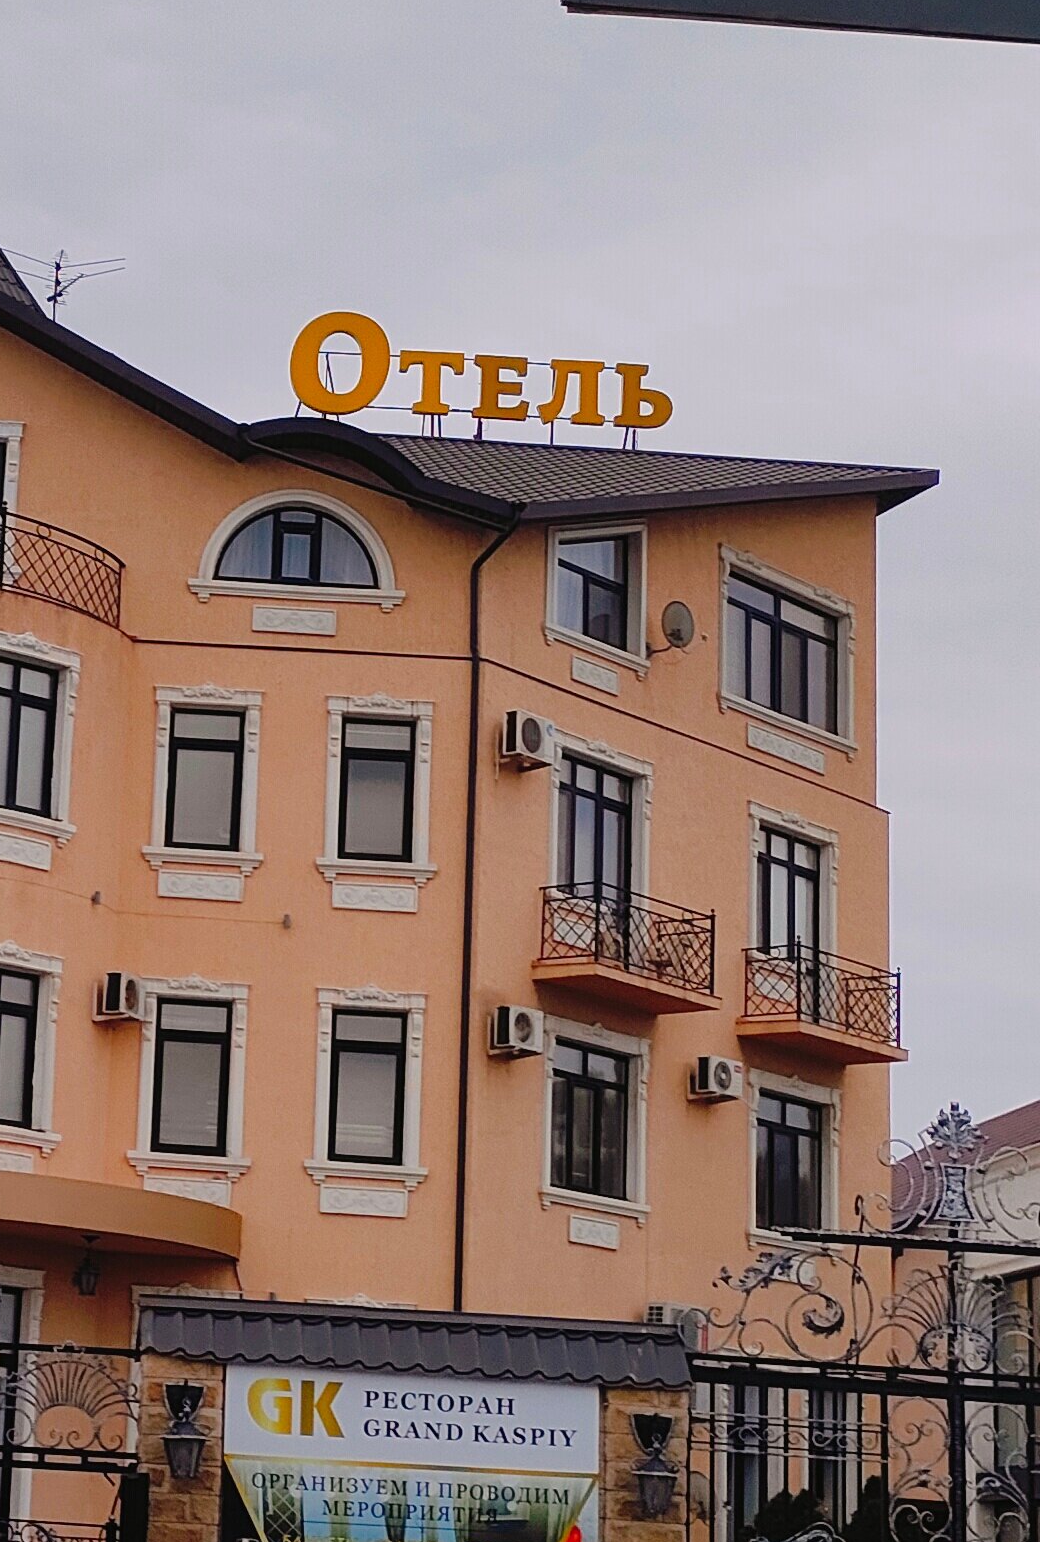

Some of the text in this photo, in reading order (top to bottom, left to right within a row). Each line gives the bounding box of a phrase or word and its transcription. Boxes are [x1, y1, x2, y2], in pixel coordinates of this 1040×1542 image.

[247, 1378, 345, 1438] GK
[364, 1390, 516, 1416] РЕСТОРАН
[363, 1419, 577, 1447] GRAND KASPIY
[251, 1472, 570, 1506] ОРГАНИЗУЕМ И ПРОВОДИМ
[322, 1499, 498, 1524] МЕРОПРИЯТИЯ
